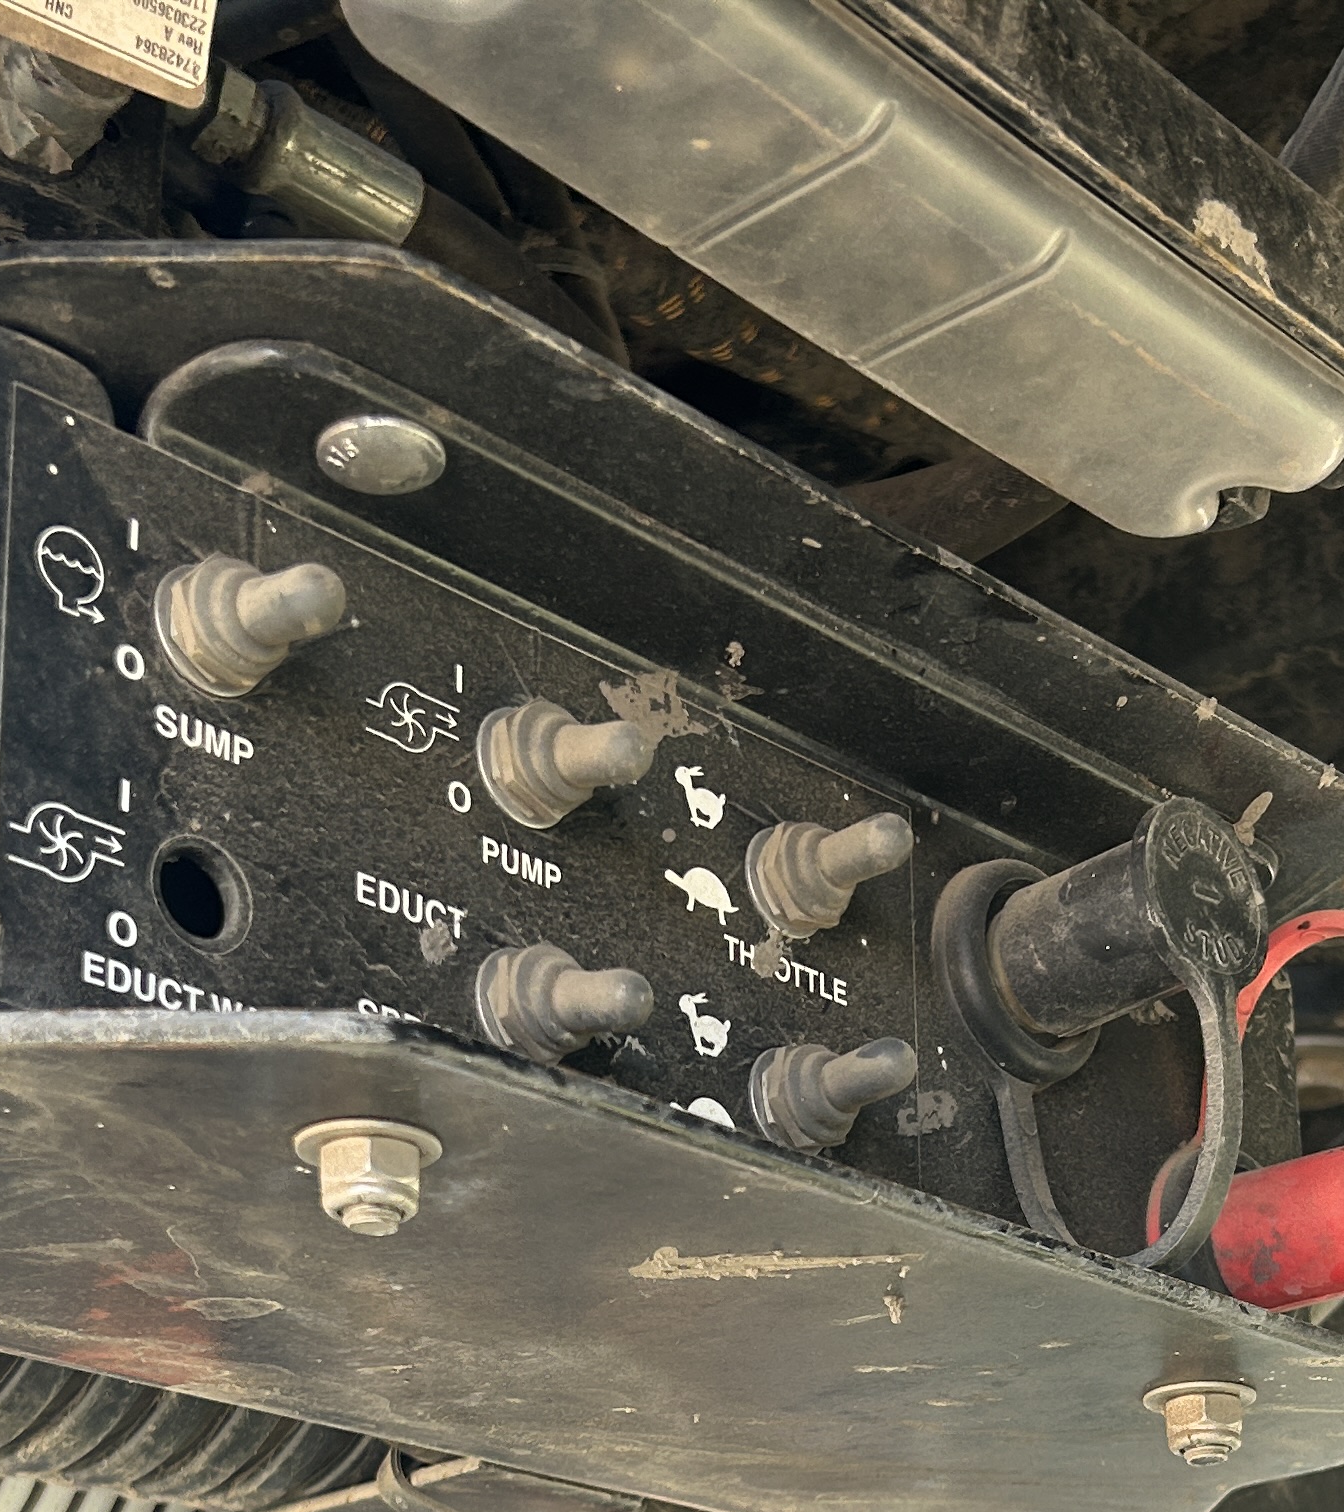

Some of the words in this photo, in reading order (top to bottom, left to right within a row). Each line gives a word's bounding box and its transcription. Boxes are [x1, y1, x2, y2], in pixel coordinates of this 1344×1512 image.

[164, 25, 173, 42] A
[178, 33, 203, 56] Rev
[156, 704, 255, 765] SUMP
[482, 836, 562, 889] PUMP
[1161, 820, 1250, 890] NEGATIVE
[356, 871, 468, 940] EDUCT
[724, 933, 848, 1007] THOTTLE
[1184, 918, 1247, 968] STUD
[82, 950, 205, 1013] EDUCT
